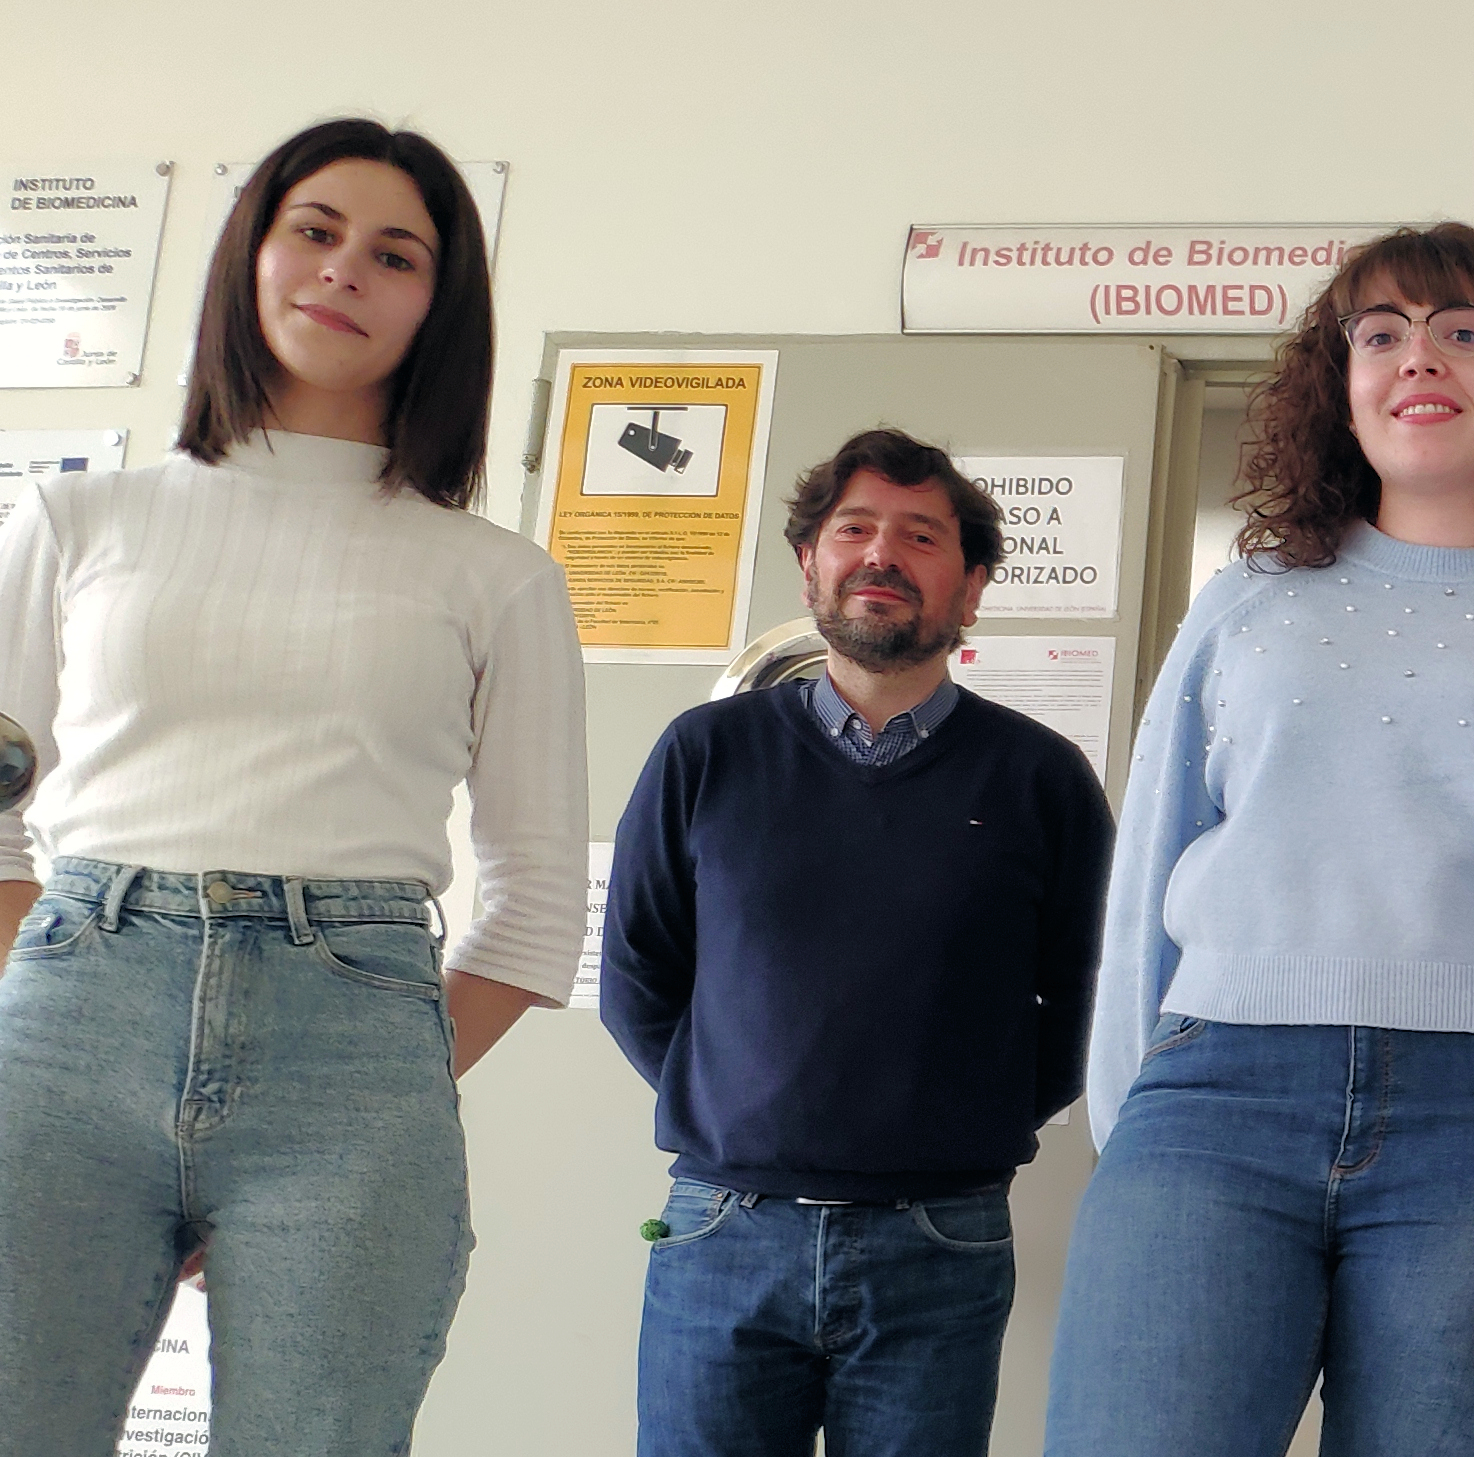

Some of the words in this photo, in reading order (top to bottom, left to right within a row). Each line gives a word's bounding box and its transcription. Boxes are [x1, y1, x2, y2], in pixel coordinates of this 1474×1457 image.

[13, 178, 95, 191] INSTITUTO
[11, 197, 33, 210] DE
[36, 195, 139, 209] BIOMEDICINA
[23, 233, 77, 244] Sanitaria
[80, 232, 96, 243] de
[3, 250, 18, 259] de
[76, 247, 132, 259] Servicios
[957, 240, 1114, 267] Instituto
[1127, 240, 1171, 267] de
[34, 263, 94, 275] Sanitarios
[98, 264, 113, 273] de
[15, 282, 24, 293] y
[26, 279, 57, 290] León
[1089, 284, 1289, 325] (IBIOMED)
[581, 376, 625, 389] ZONA
[628, 376, 747, 389] VIDEOVIGILADA
[1046, 506, 1062, 526] A
[1002, 536, 1064, 555] ONAL
[992, 565, 1098, 585] ORIZADO
[151, 1385, 196, 1396] Miembro
